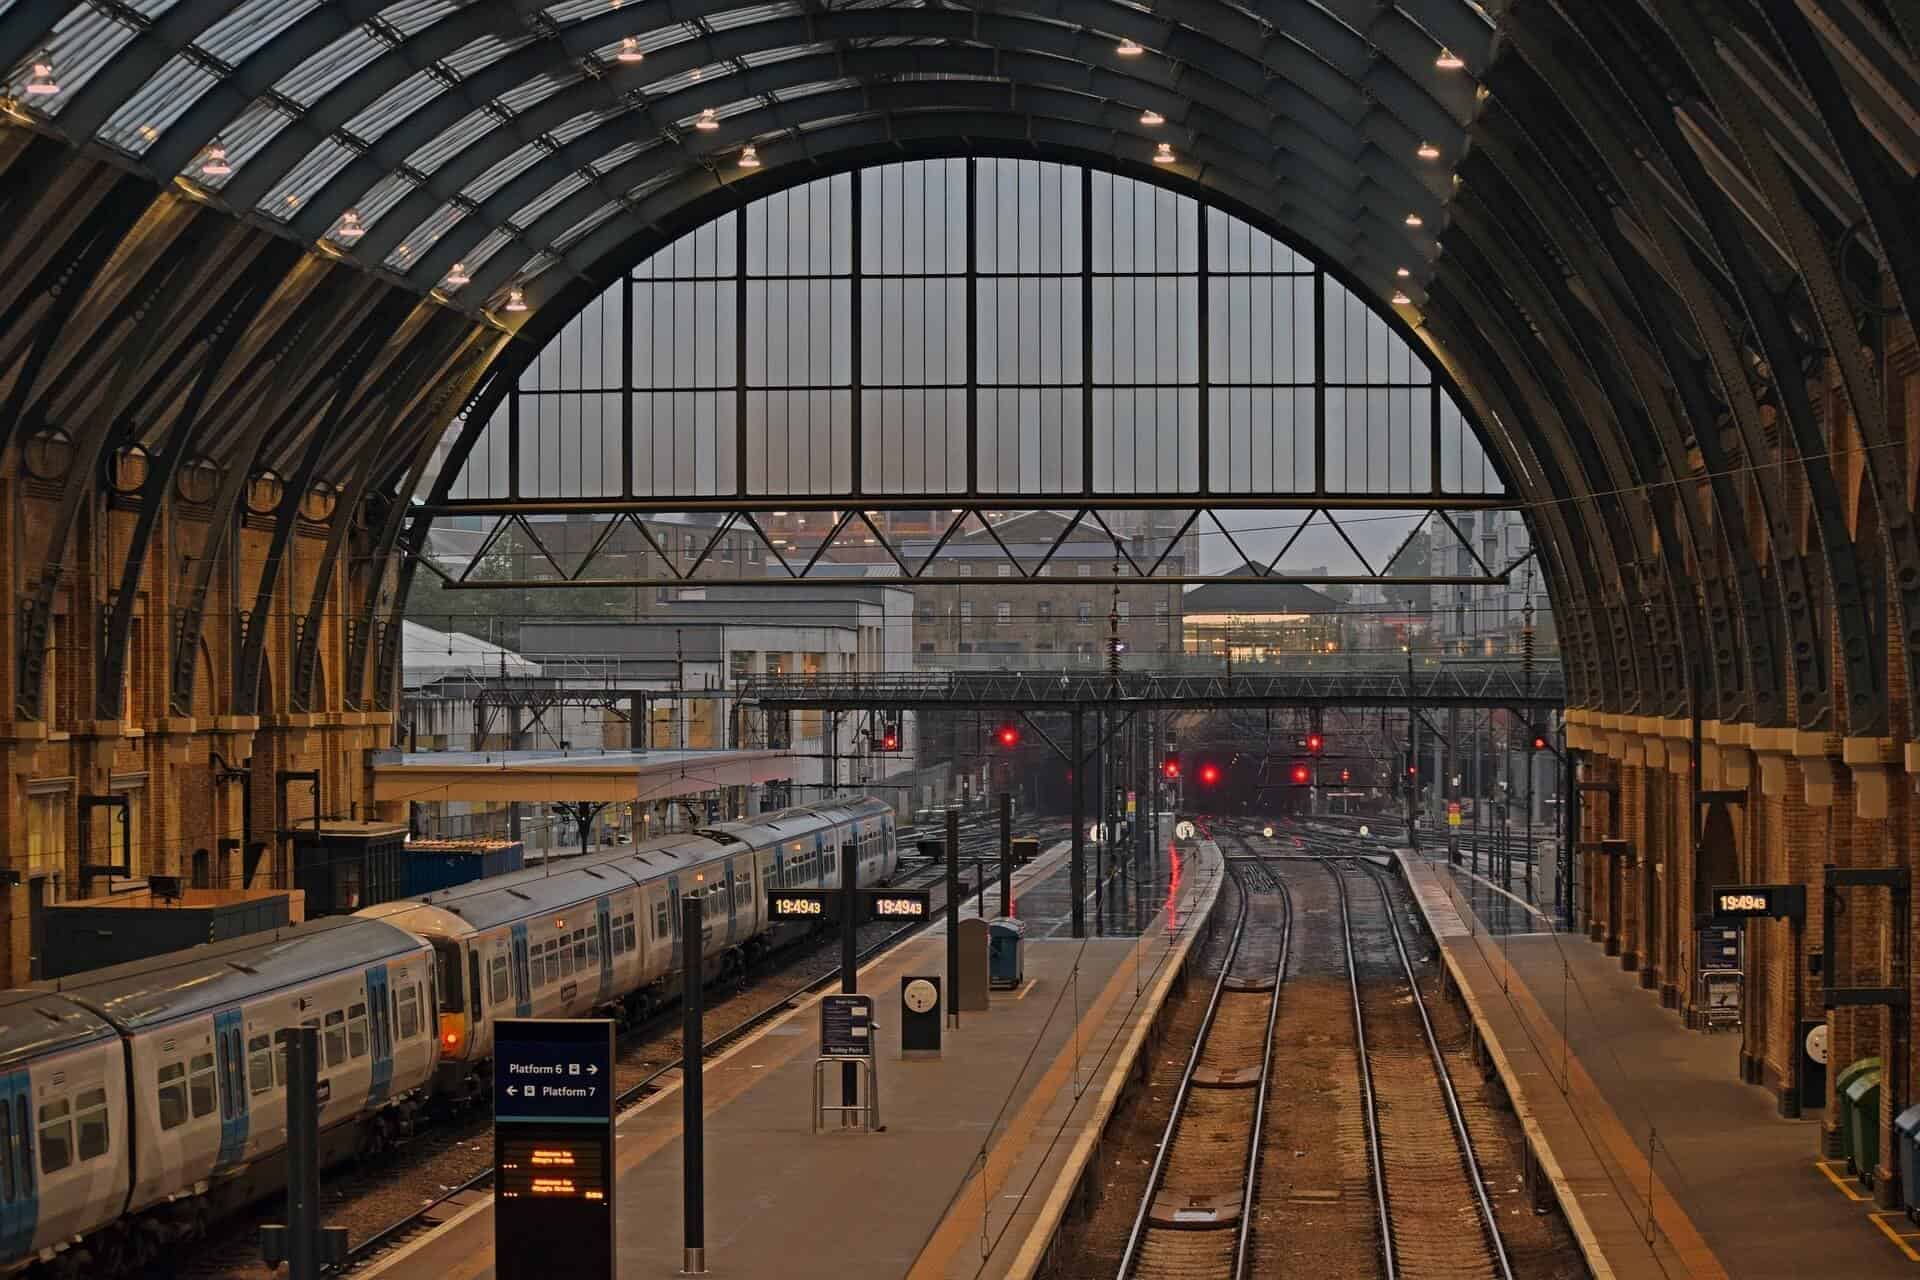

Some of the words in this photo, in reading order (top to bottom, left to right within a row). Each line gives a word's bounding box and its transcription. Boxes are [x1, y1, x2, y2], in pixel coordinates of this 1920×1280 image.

[509, 1063, 553, 1075] Platform
[555, 1064, 563, 1075] 6
[542, 1086, 586, 1097] Platform
[587, 1087, 596, 1097] 7
